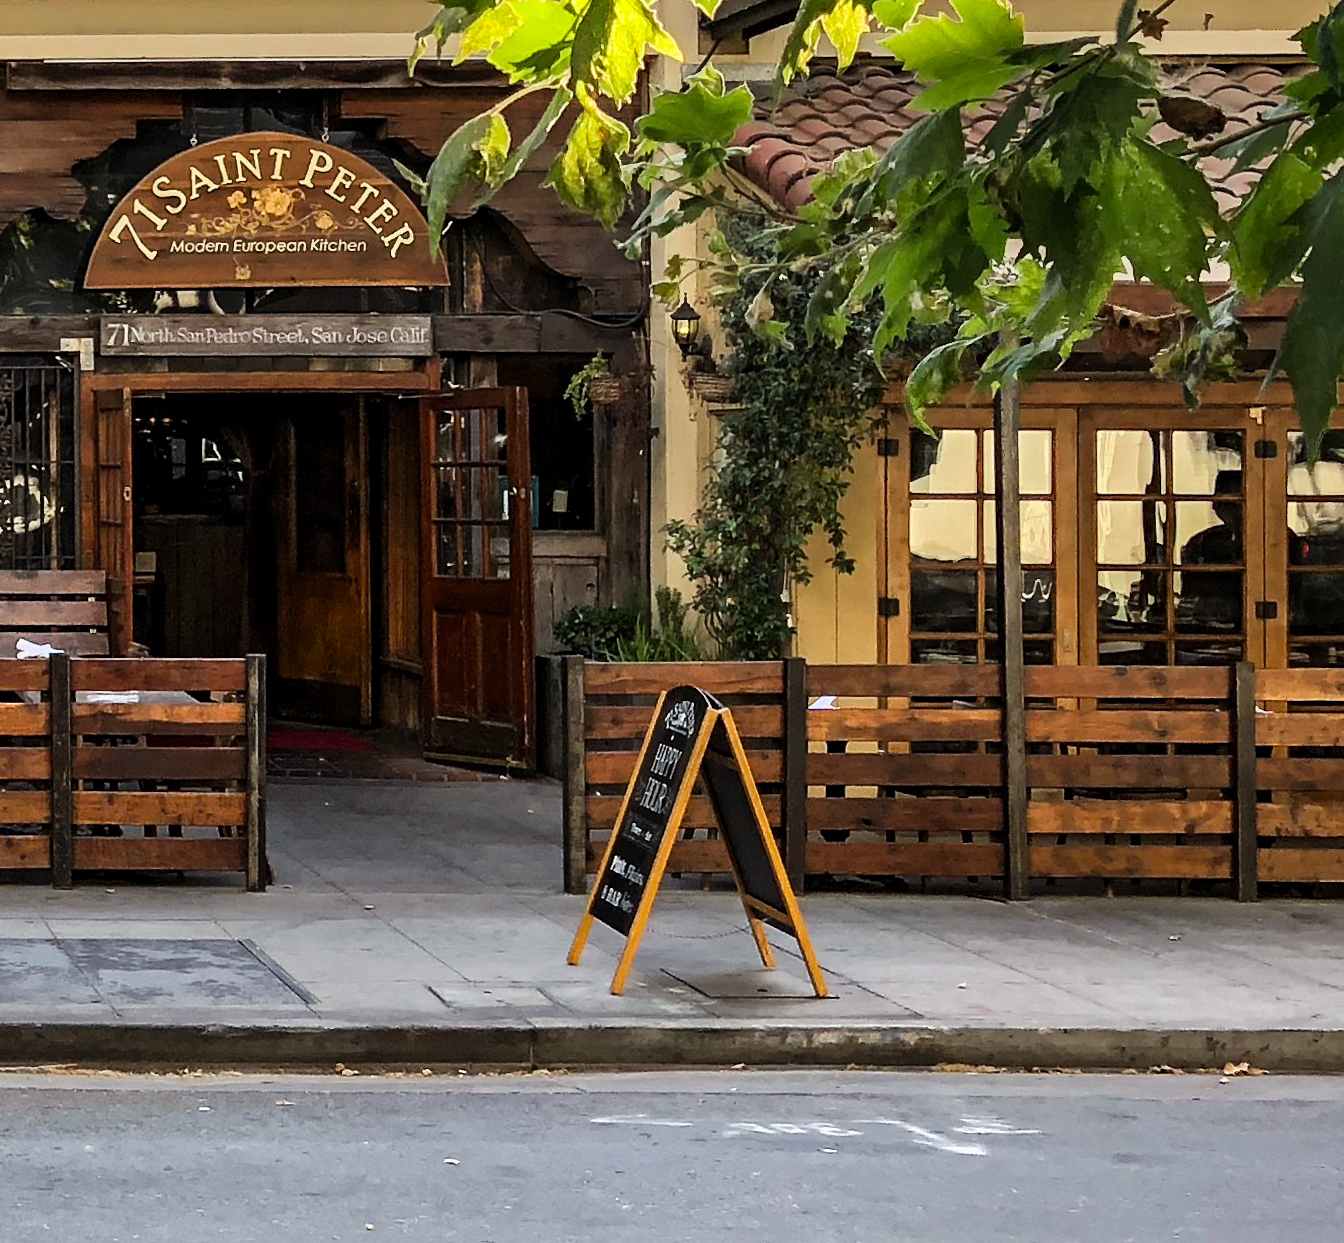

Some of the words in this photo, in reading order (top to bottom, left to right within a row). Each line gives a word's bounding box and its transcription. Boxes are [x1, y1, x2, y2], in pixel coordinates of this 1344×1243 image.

[108, 198, 168, 261] 71
[152, 149, 291, 215] SAINT
[299, 148, 415, 259] PETER
[170, 240, 229, 254] Modern
[232, 239, 306, 254] European
[310, 239, 367, 252] Kitchen
[106, 323, 130, 347] 71
[130, 325, 174, 343] North
[177, 327, 205, 343] San
[205, 326, 250, 344] Pedro
[252, 326, 309, 344] Street,
[311, 326, 343, 344] San
[346, 326, 388, 344] Jose
[651, 743, 682, 779] HAPPY
[639, 777, 668, 814] HOUR
